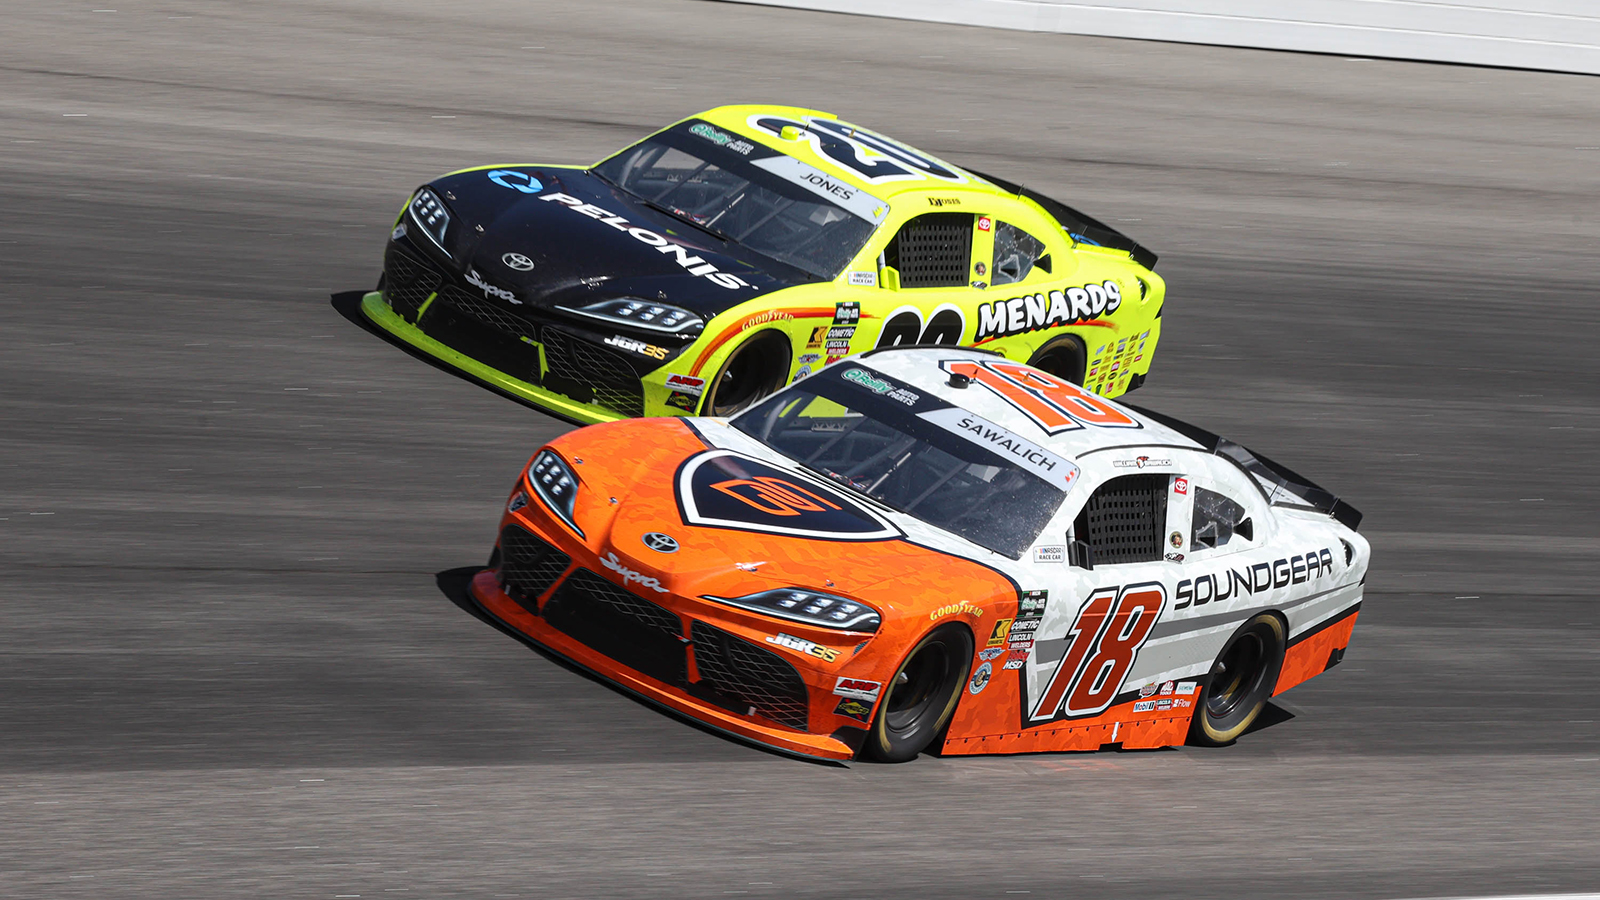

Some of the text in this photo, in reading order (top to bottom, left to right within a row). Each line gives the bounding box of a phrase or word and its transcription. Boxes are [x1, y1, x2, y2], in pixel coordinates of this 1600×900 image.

[800, 172, 854, 200] JONES
[538, 192, 750, 290] PELONIS
[464, 269, 523, 305] Supra
[742, 309, 795, 331] GOODYEAR
[976, 281, 1121, 342] MENARDS
[668, 375, 704, 386] ARP
[844, 368, 919, 401] O'Reilly AUTO
[887, 391, 915, 406] PARTS
[938, 360, 1144, 436] 18
[957, 417, 1055, 471] SAWALICH
[600, 552, 669, 593] Supra
[1175, 548, 1333, 611] SOUNDGEAR
[930, 600, 983, 620] GOODYEAR
[1011, 620, 1040, 630] COMETIC
[765, 632, 842, 663] JGR35
[1009, 633, 1032, 641] LINCOLN
[1030, 581, 1167, 722] 18
[1003, 661, 1023, 669] MSD
[838, 679, 878, 691] ARP
